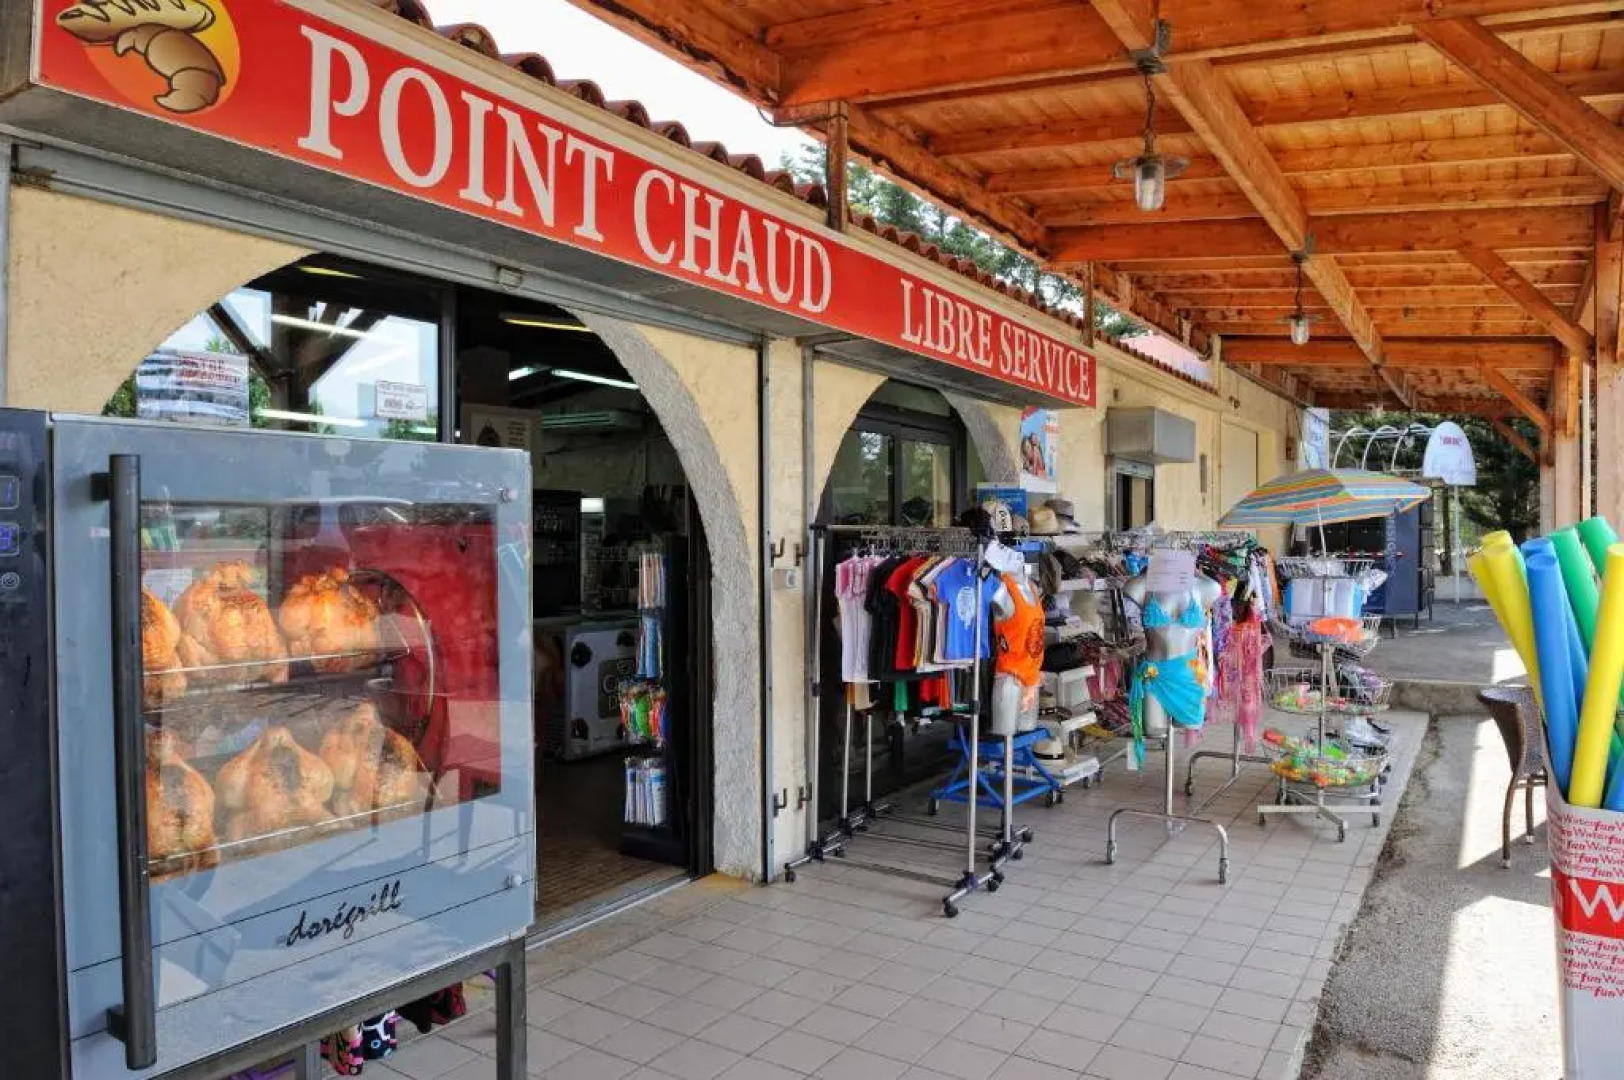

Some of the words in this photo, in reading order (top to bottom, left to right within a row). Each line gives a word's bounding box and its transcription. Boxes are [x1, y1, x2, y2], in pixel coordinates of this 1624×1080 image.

[297, 24, 615, 242] POINT
[633, 169, 832, 313] CHAUD
[900, 278, 994, 369] LIBRE
[999, 321, 1091, 401] SERVICE
[286, 879, 401, 946] dorégrill
